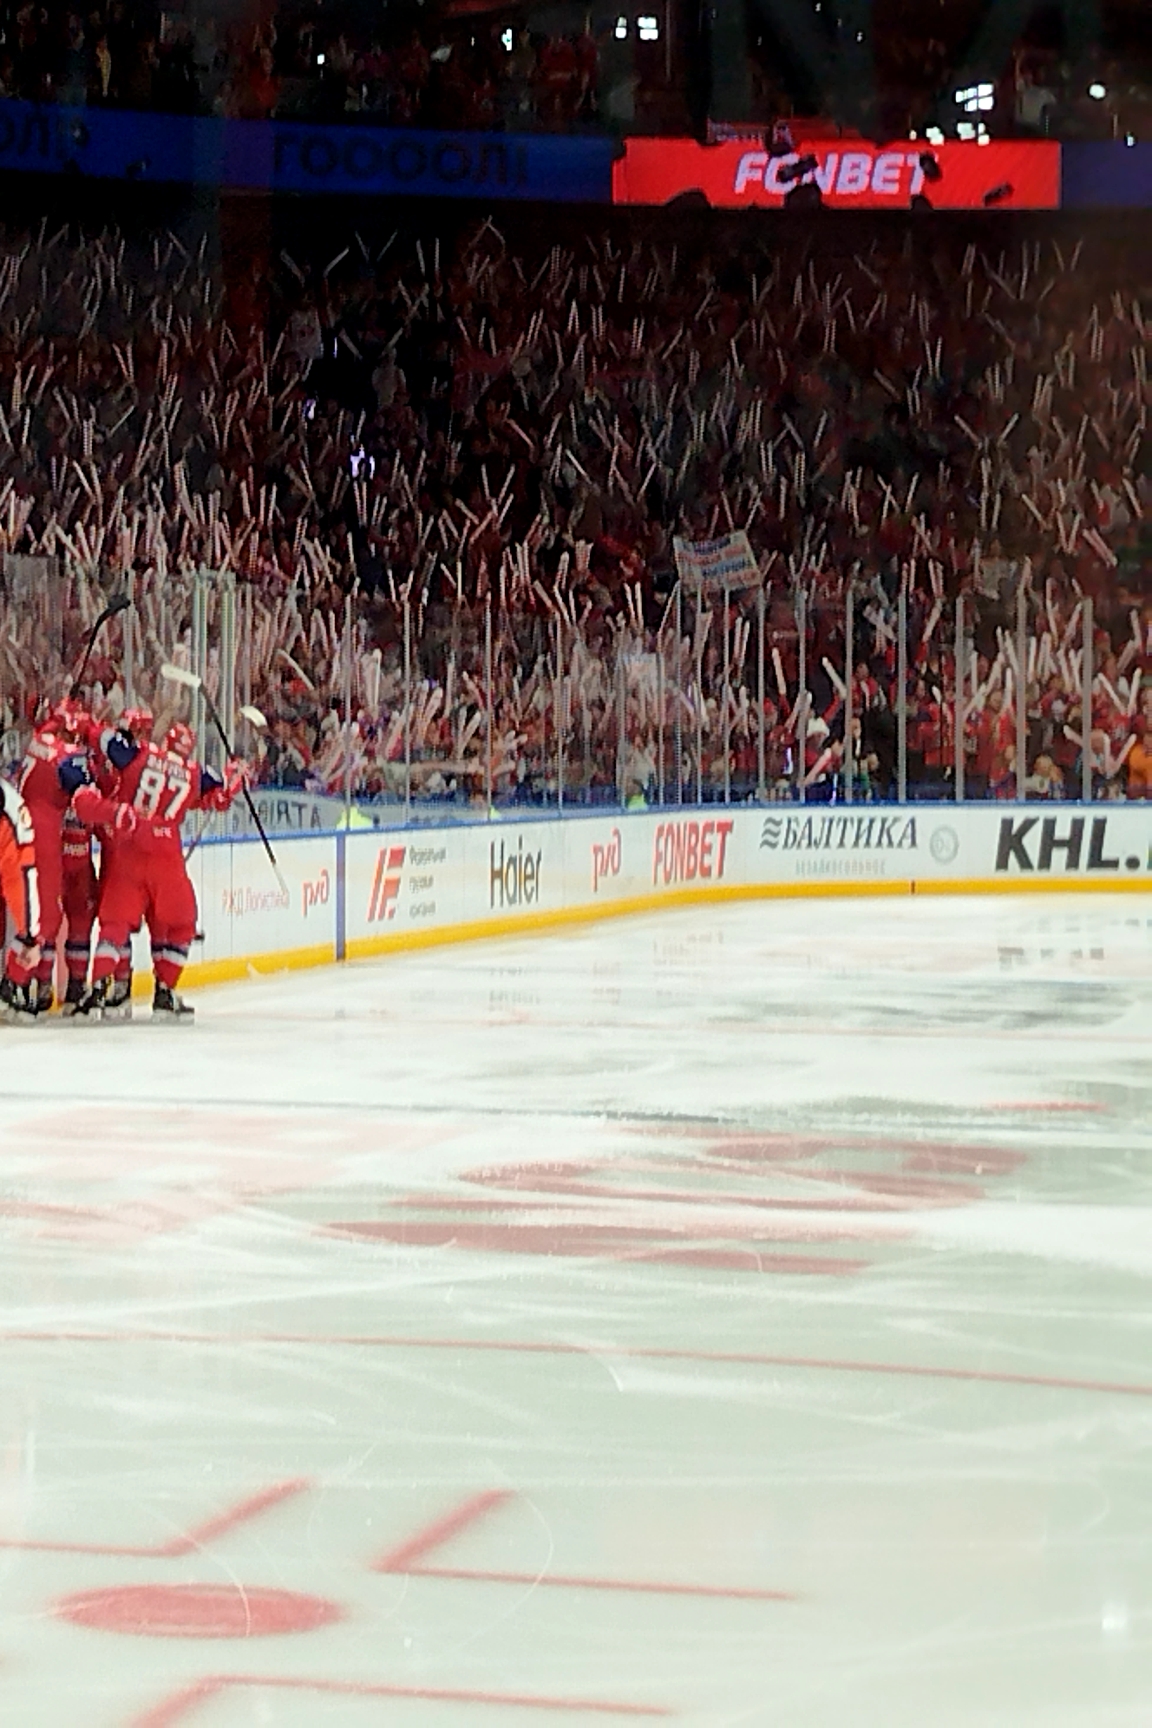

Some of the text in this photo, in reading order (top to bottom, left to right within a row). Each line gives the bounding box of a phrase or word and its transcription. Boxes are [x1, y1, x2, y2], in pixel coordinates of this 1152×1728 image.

[133, 768, 191, 821] 87
[652, 819, 735, 887] FONBET
[781, 815, 919, 851] БАЛТИКА
[489, 836, 543, 909] Haier
